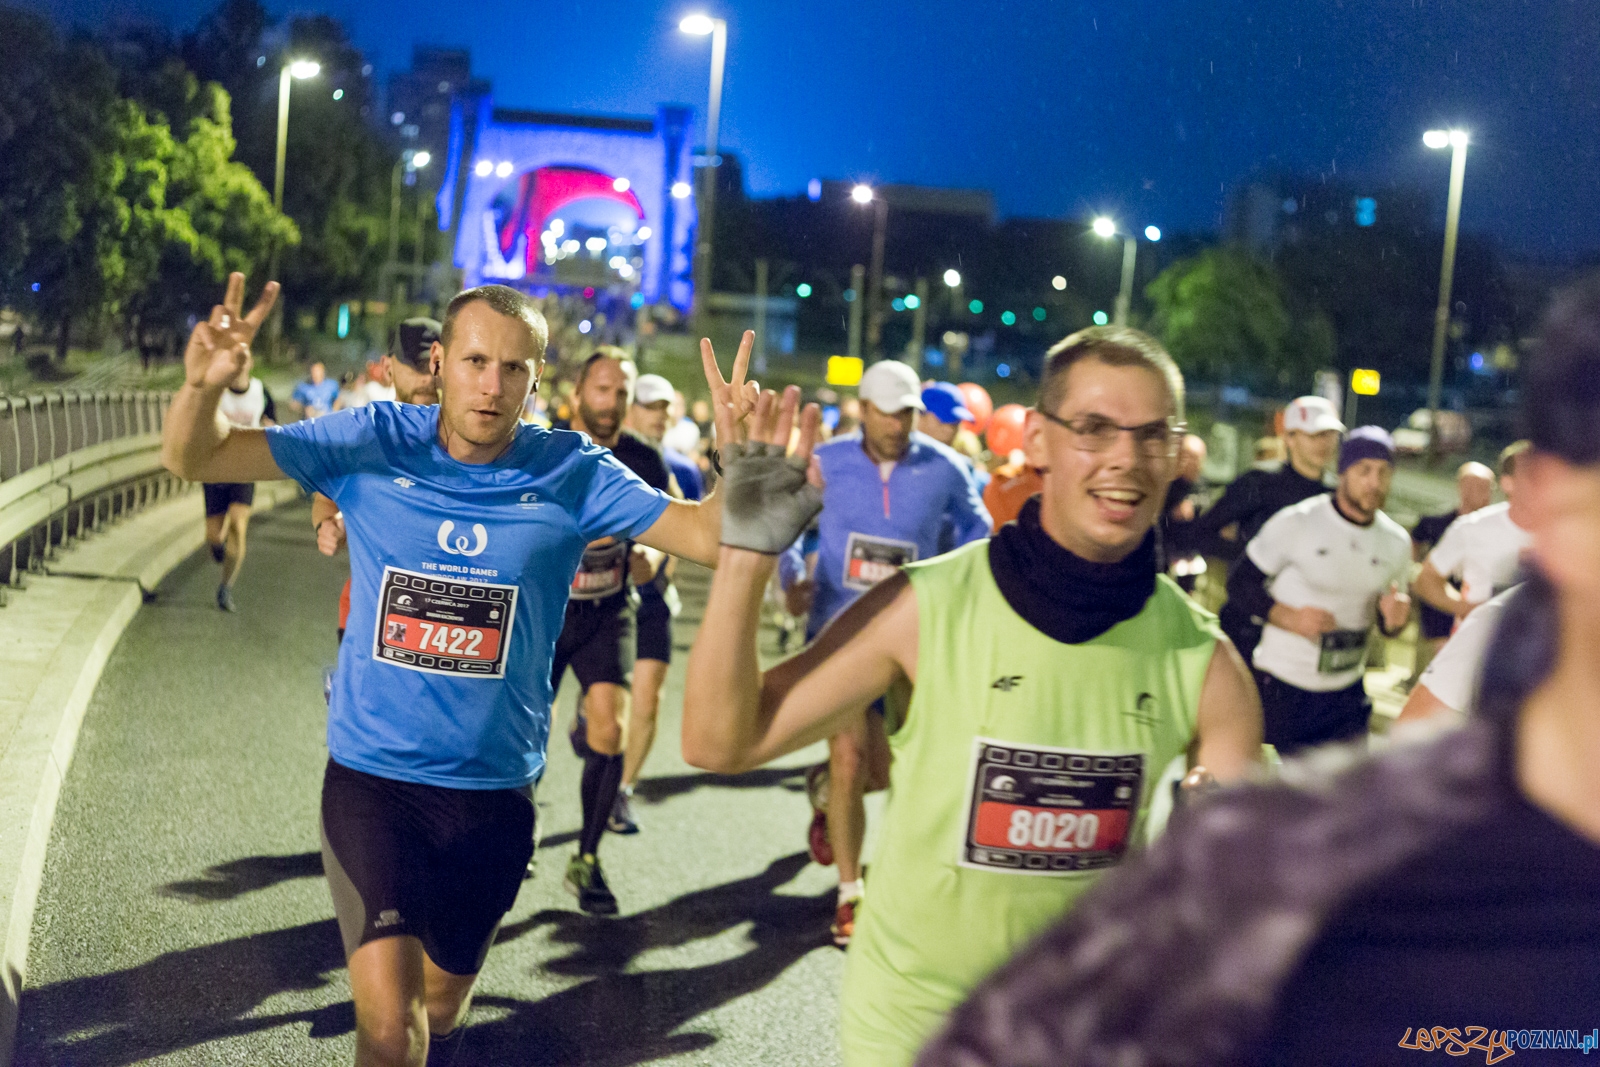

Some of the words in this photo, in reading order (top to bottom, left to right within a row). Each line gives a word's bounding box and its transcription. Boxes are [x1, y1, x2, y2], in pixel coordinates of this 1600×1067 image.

[393, 477, 416, 489] 4F
[422, 562, 437, 570] THE
[439, 564, 468, 573] WORLD
[470, 567, 498, 576] GAMES
[419, 622, 484, 657] 7422
[991, 675, 1024, 692] 4F
[1007, 809, 1099, 849] 8020
